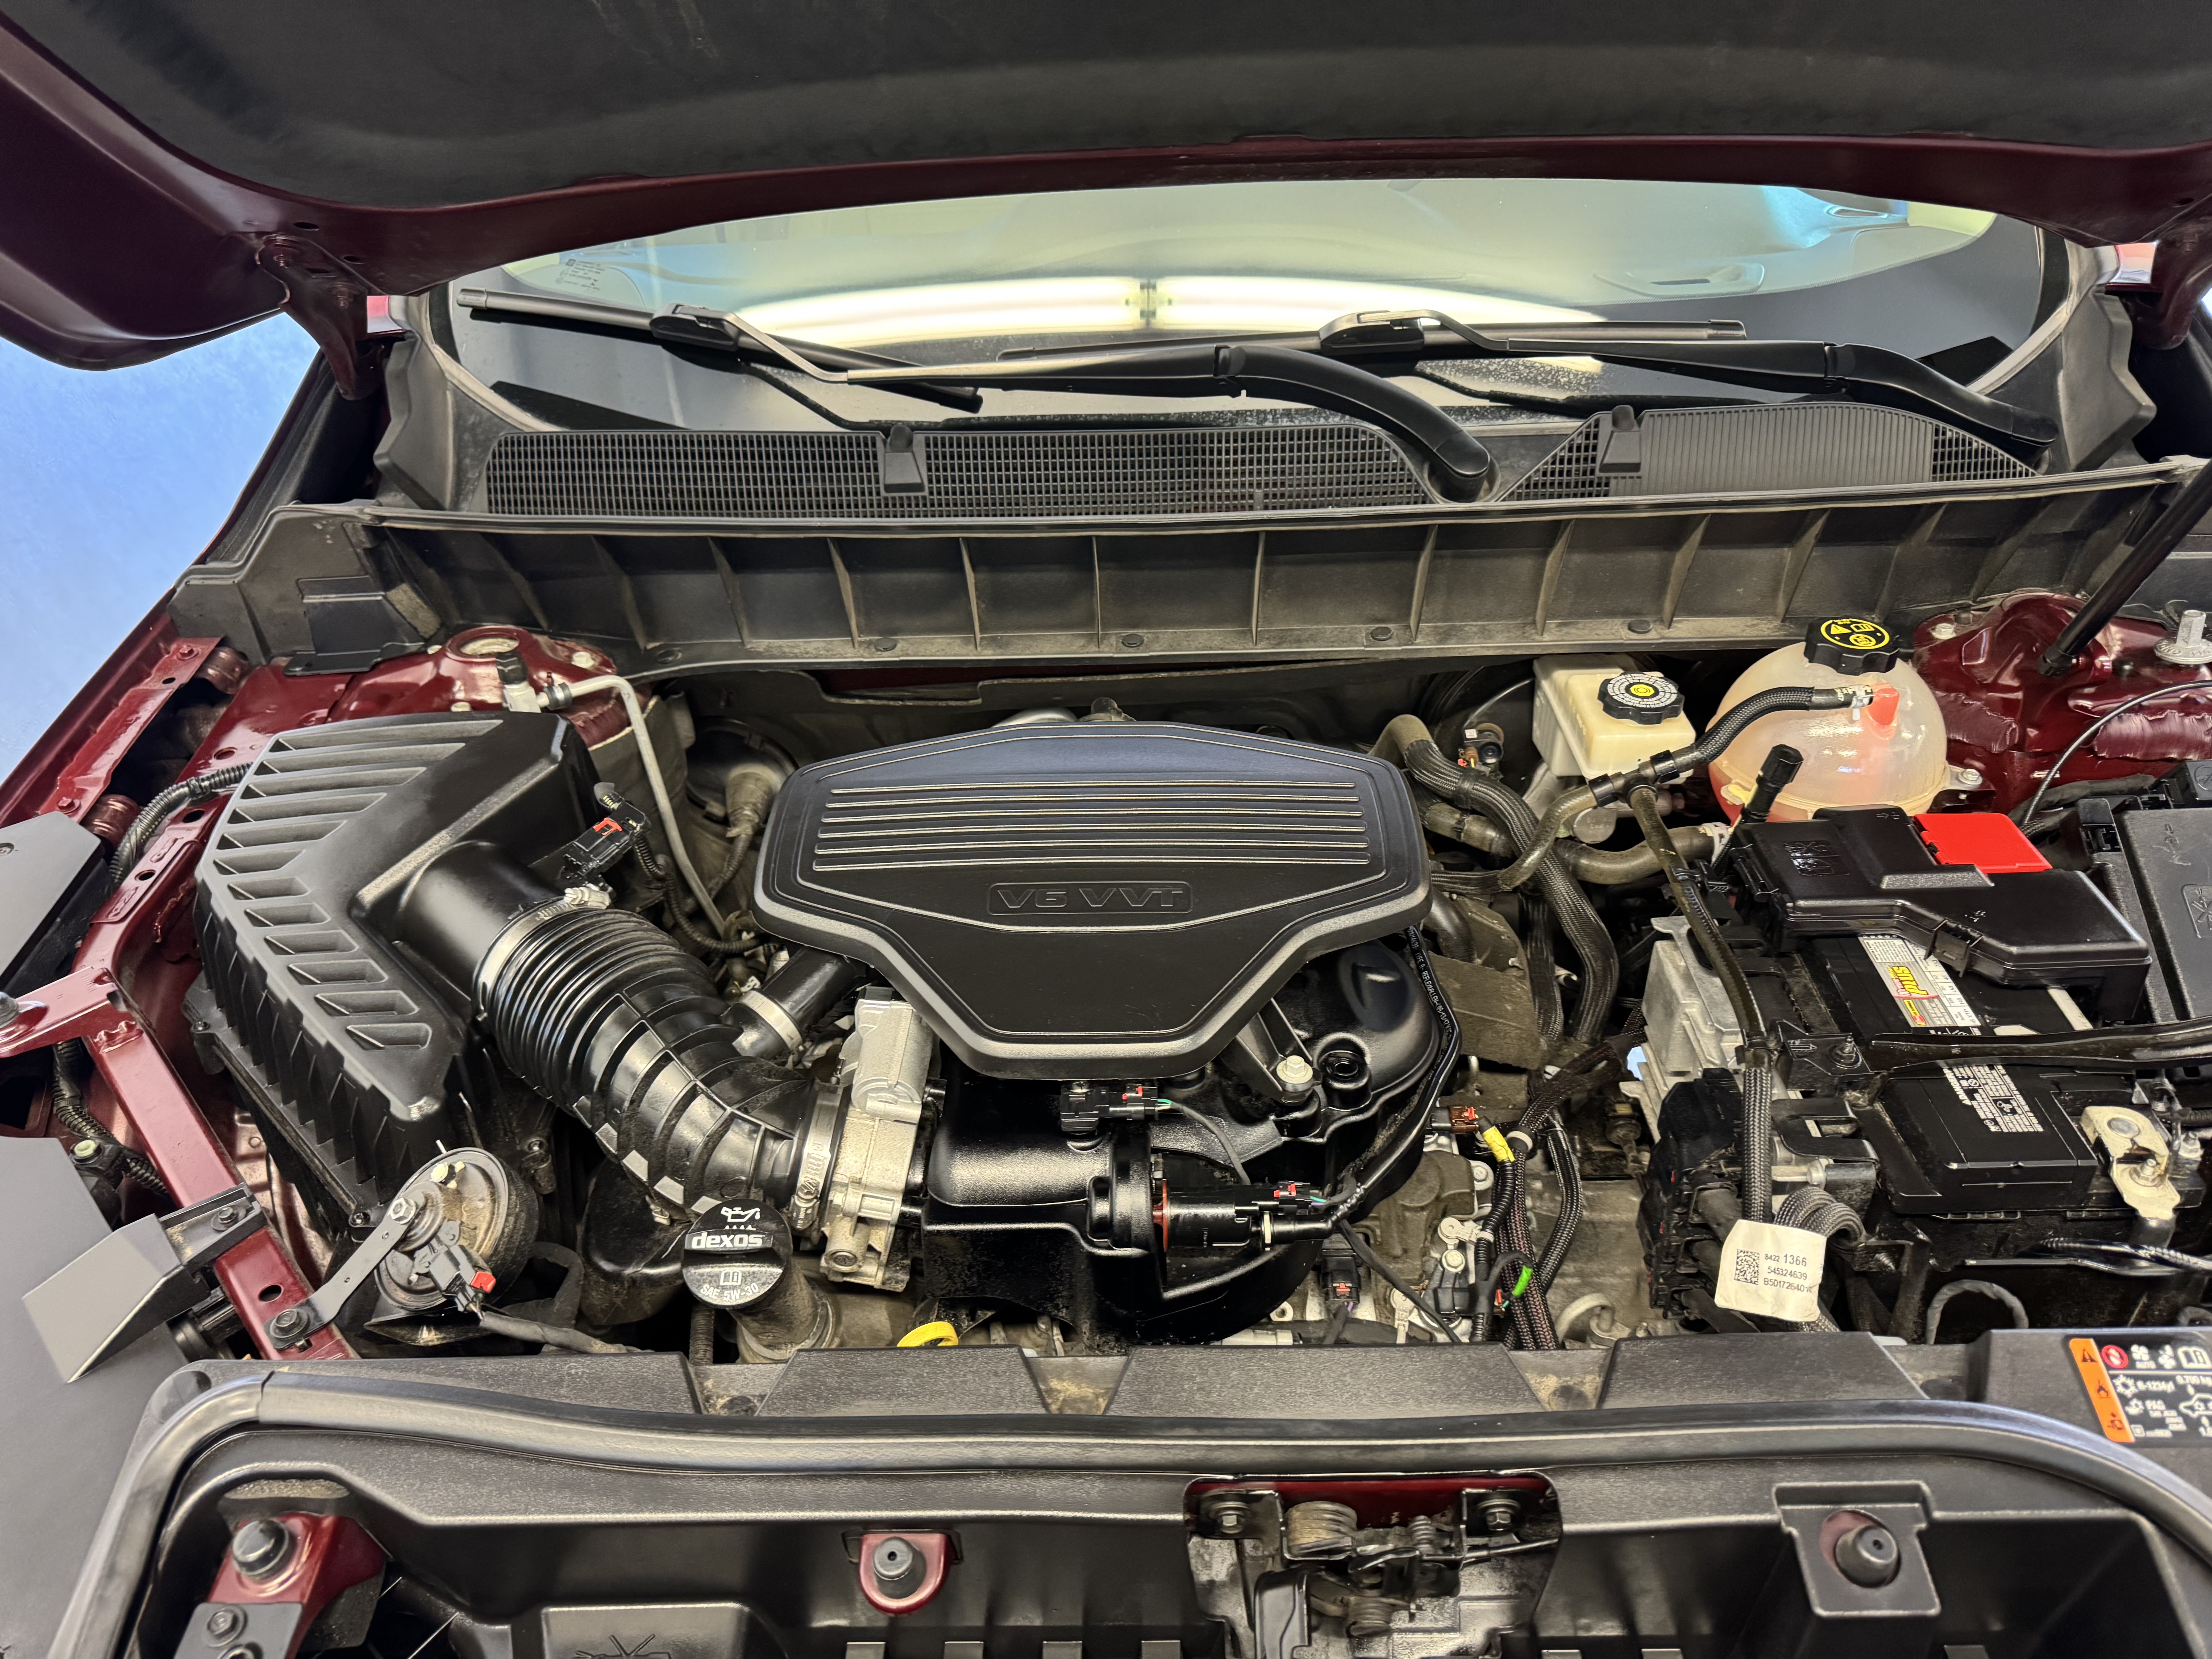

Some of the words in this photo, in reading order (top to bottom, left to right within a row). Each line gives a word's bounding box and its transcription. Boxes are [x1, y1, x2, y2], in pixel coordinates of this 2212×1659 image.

[998, 888, 1066, 908] V6
[1080, 887, 1183, 907] VVT
[692, 1232, 763, 1249] dexos
[1765, 1254, 1780, 1262] 8422
[1784, 1253, 1807, 1267] 1366
[701, 1284, 720, 1299] SAE
[723, 1283, 759, 1301] 5W-30
